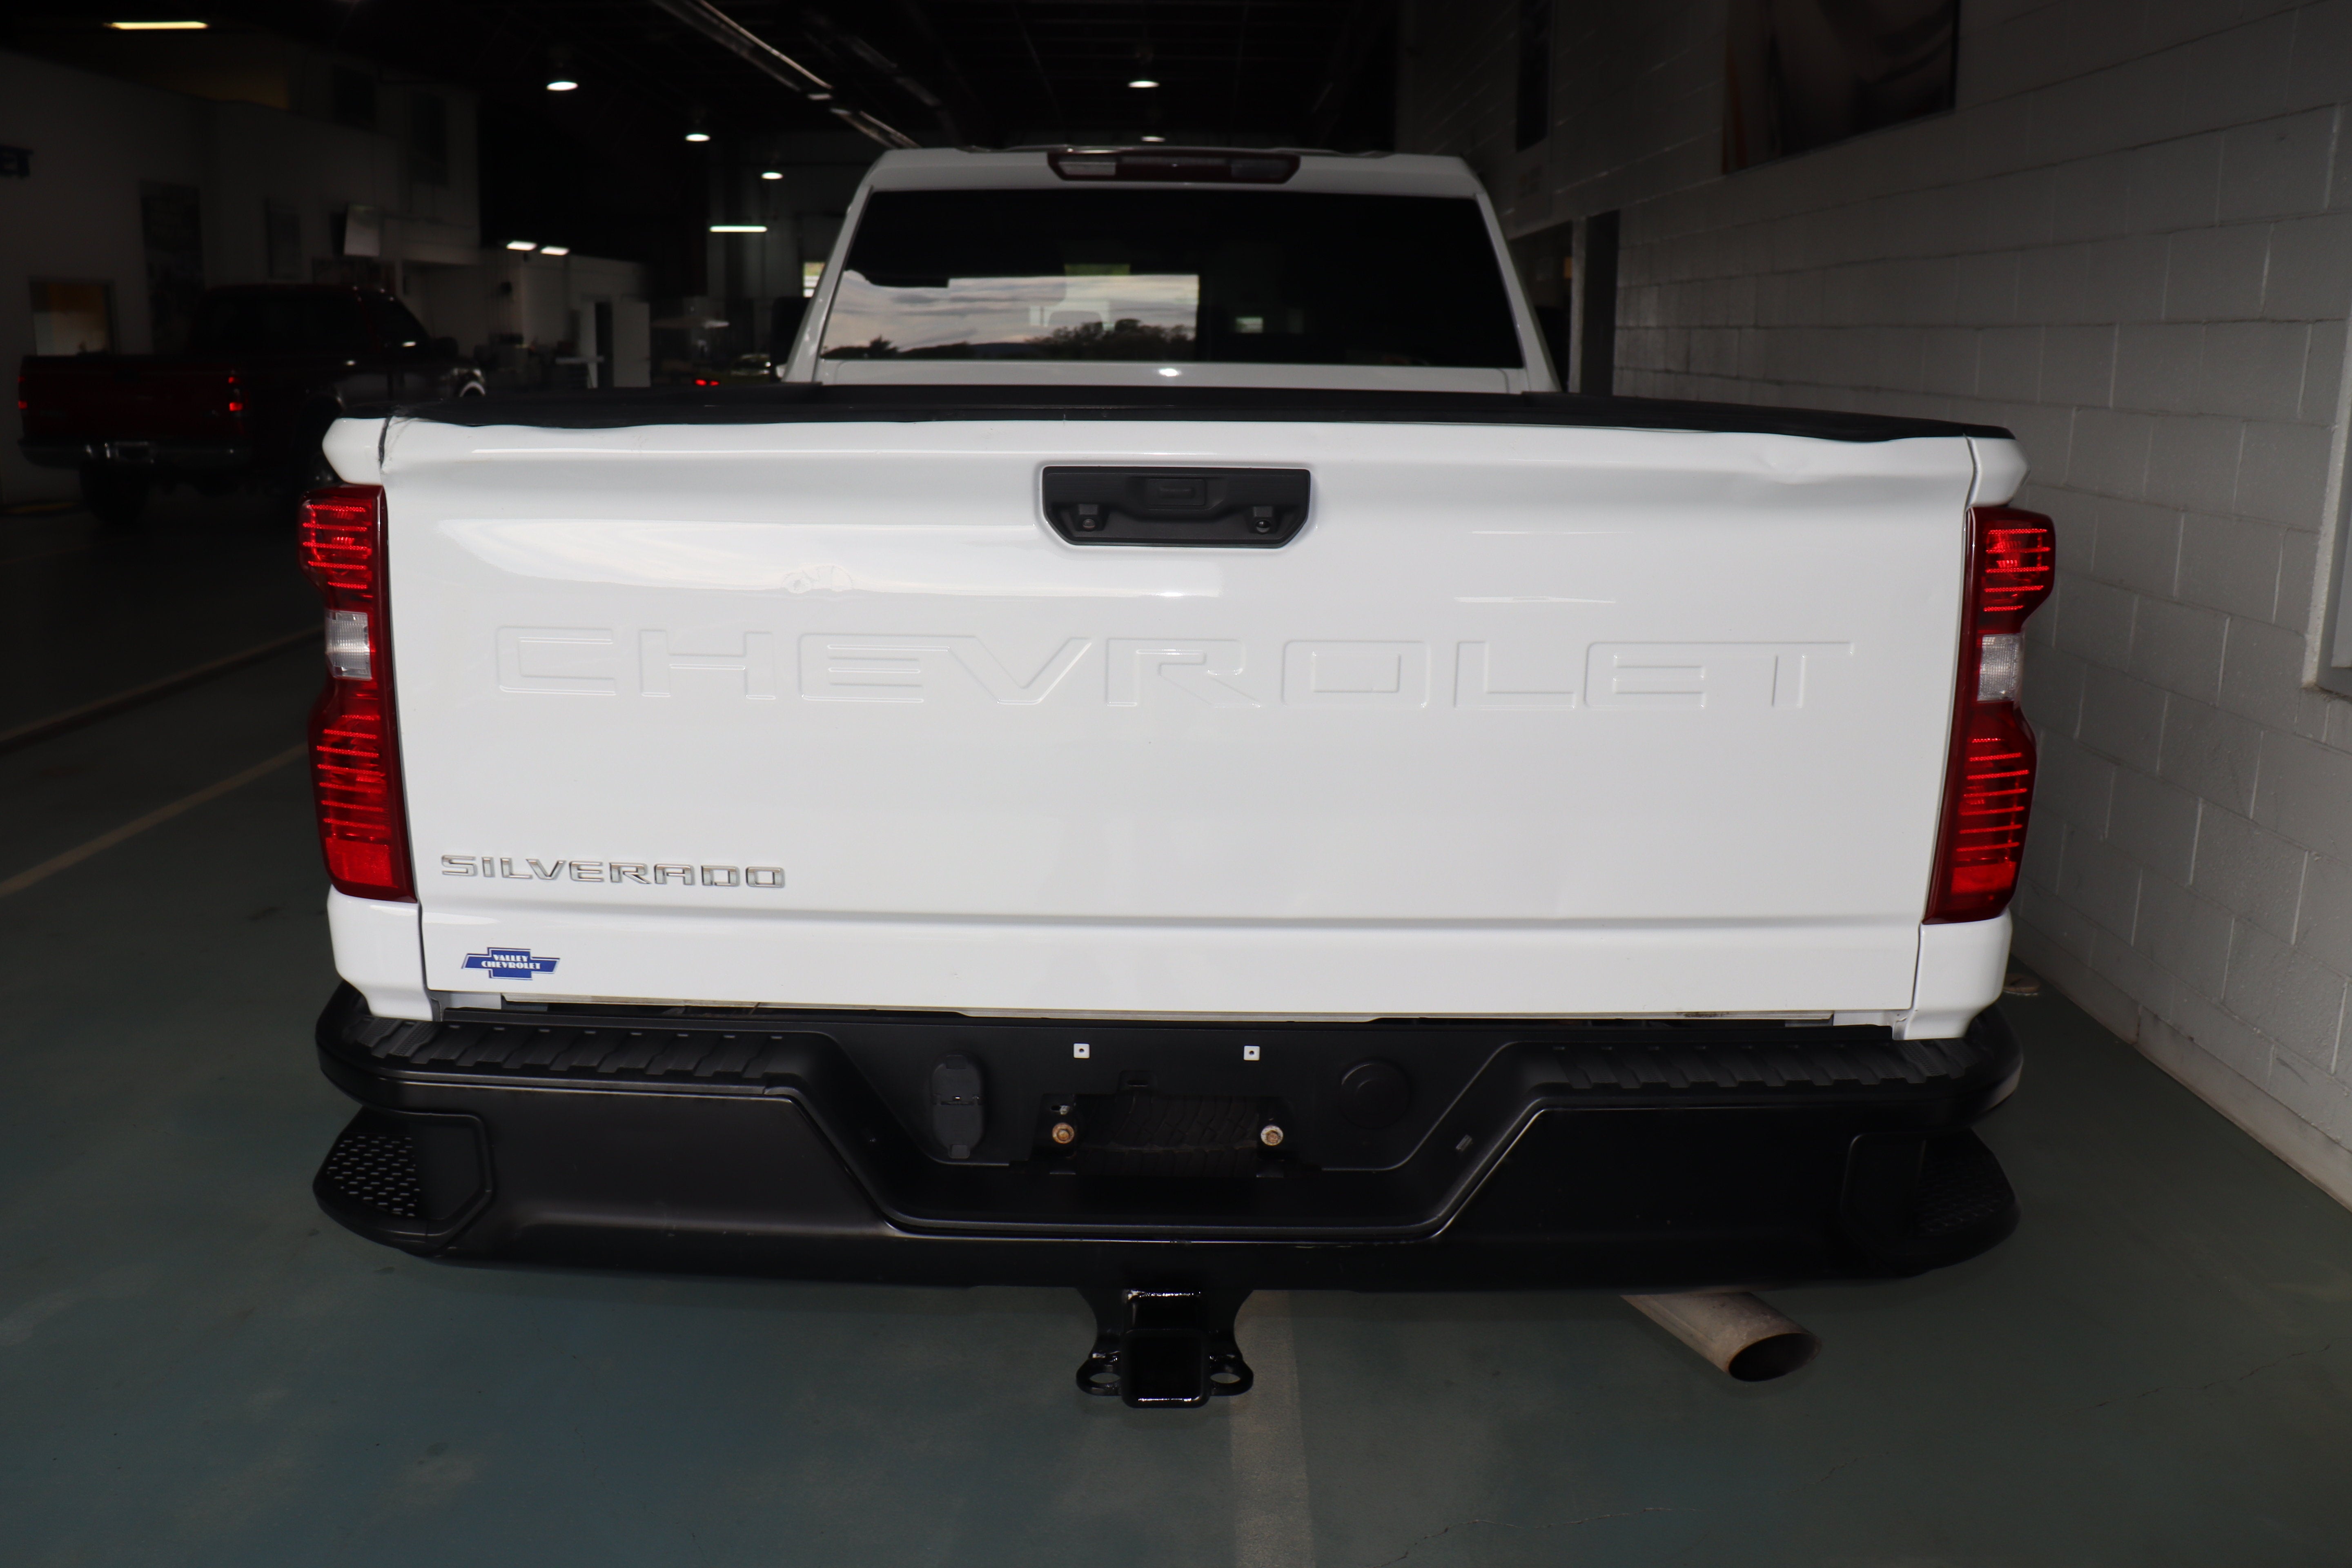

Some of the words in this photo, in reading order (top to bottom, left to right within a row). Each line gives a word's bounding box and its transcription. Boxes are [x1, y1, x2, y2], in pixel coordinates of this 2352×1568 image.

[495, 626, 1854, 710] CHEVROLET
[441, 854, 785, 888] SILVERADO
[481, 960, 541, 969] CHEVROLET
